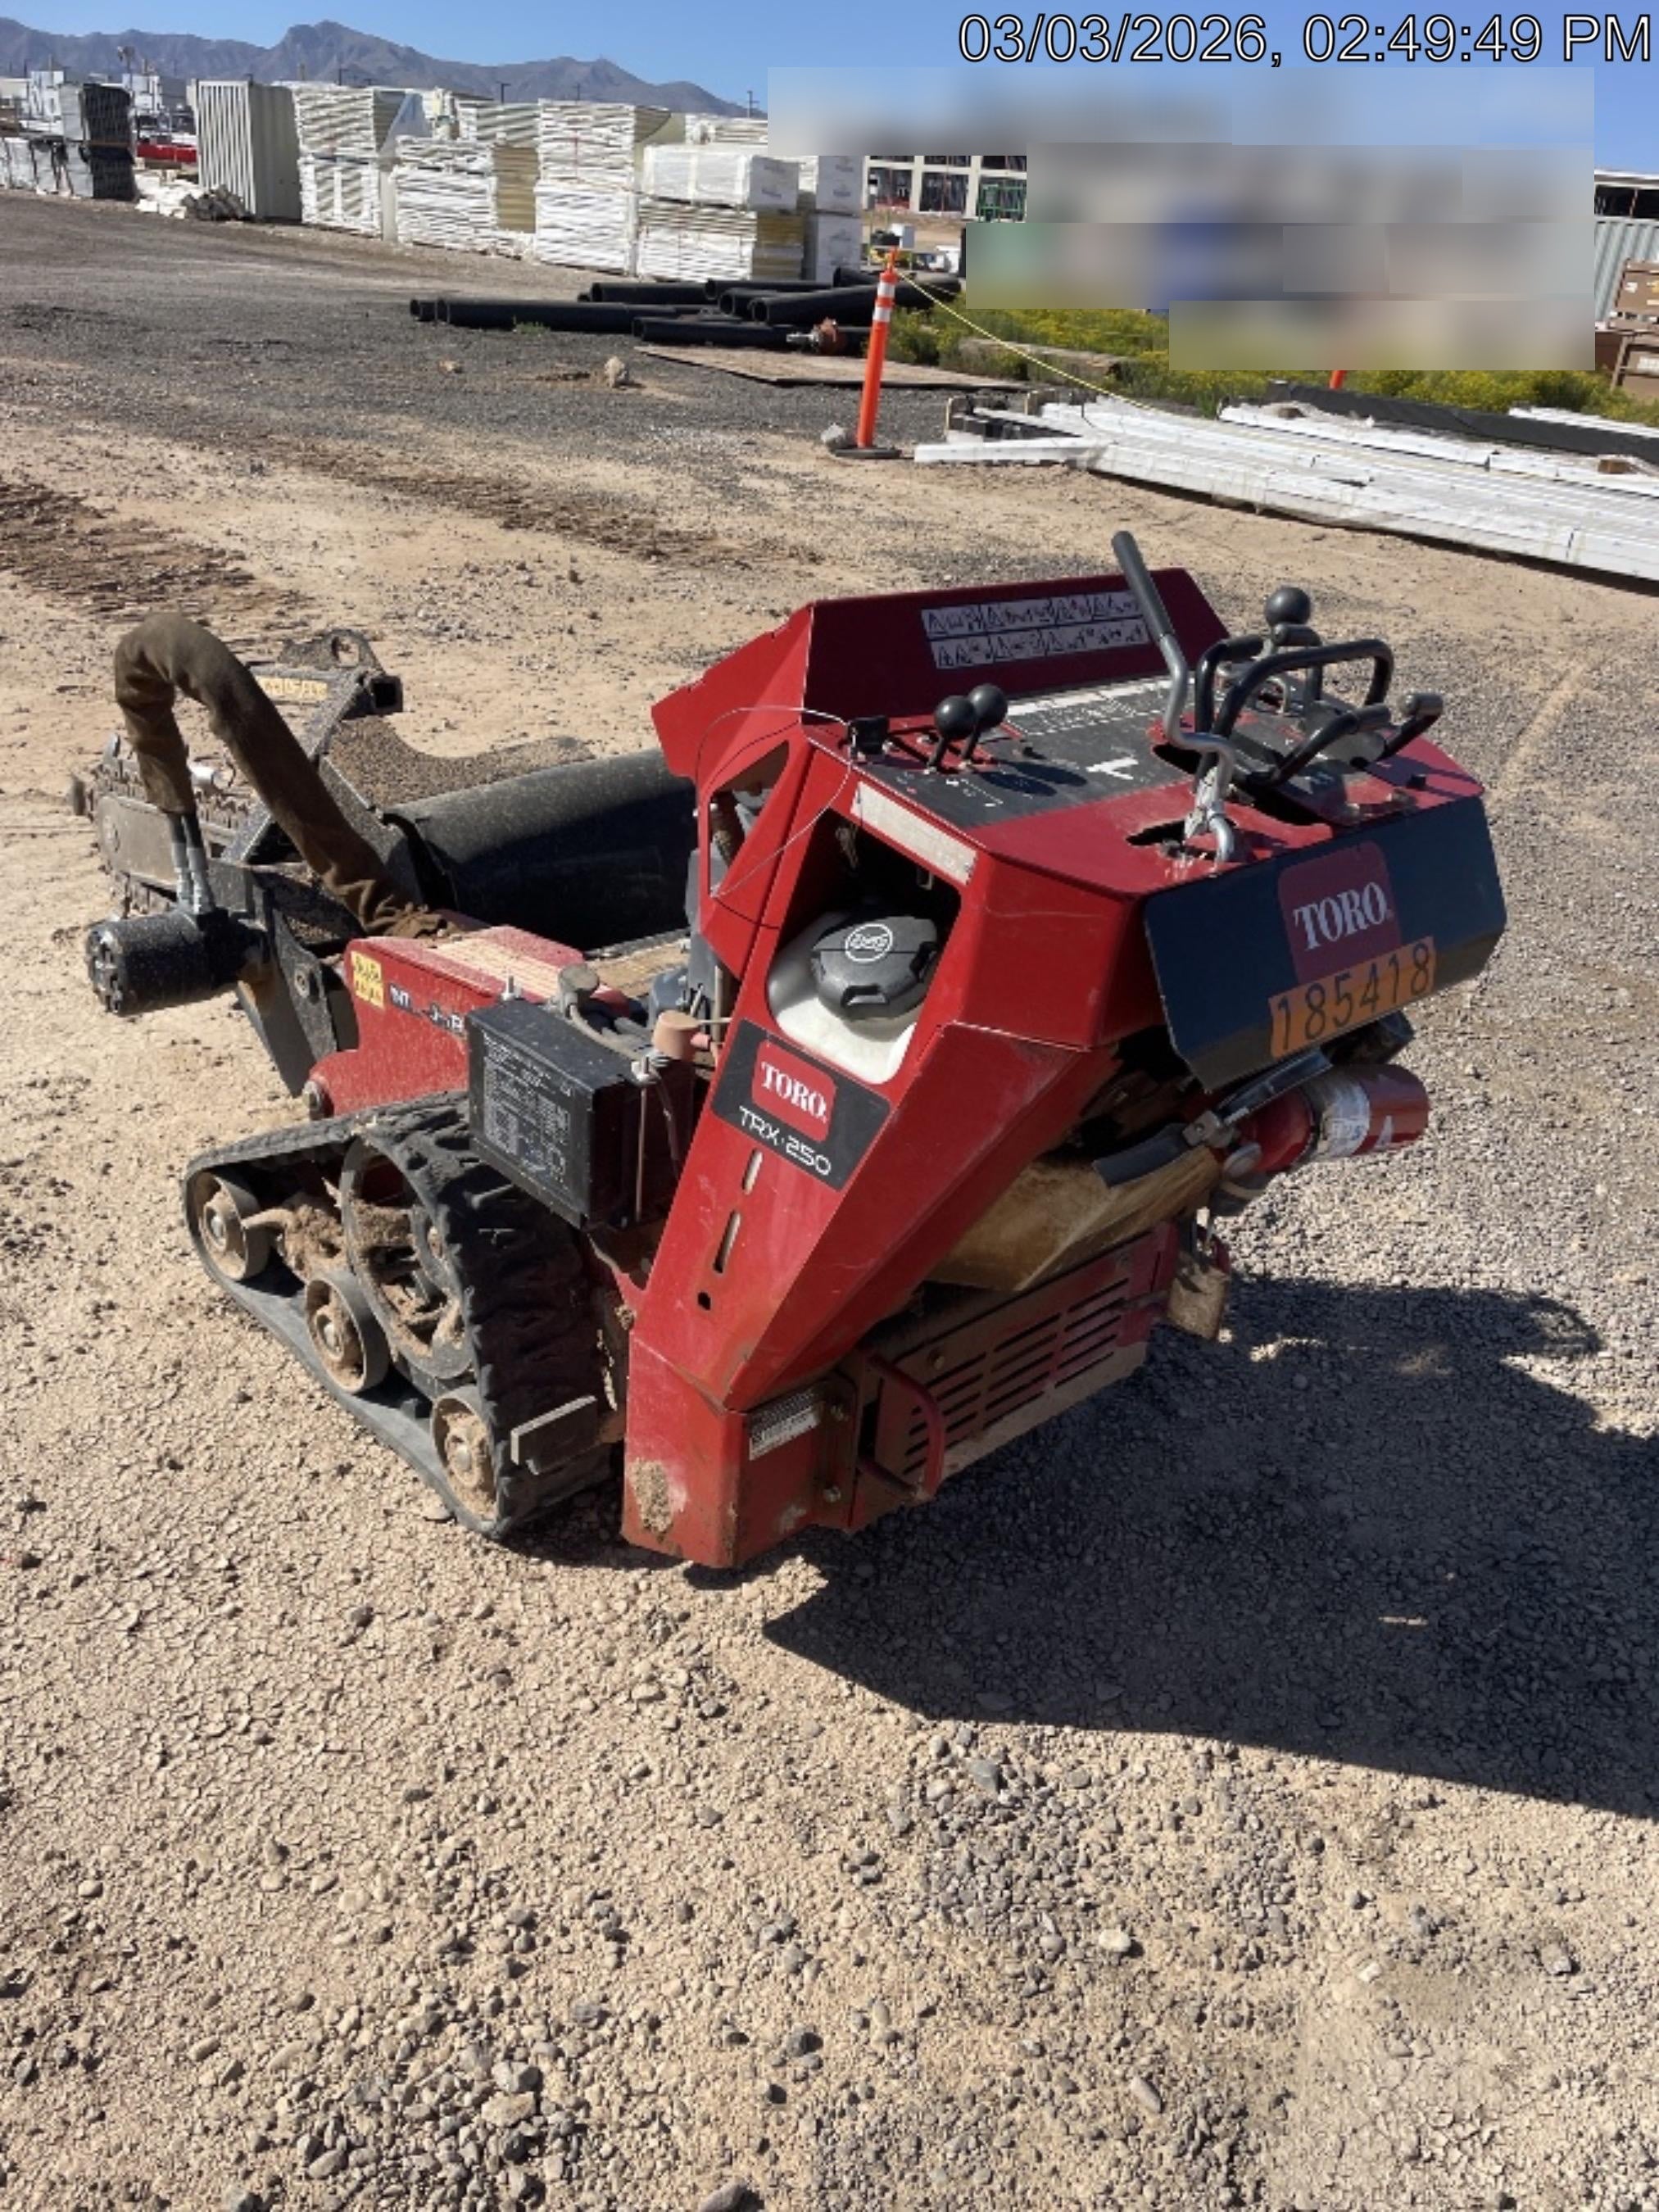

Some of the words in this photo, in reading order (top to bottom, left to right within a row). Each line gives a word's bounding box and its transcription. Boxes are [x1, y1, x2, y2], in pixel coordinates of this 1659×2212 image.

[1293, 882, 1389, 950] TORO
[1278, 942, 1430, 1051] 185418
[760, 1062, 827, 1122] TORO
